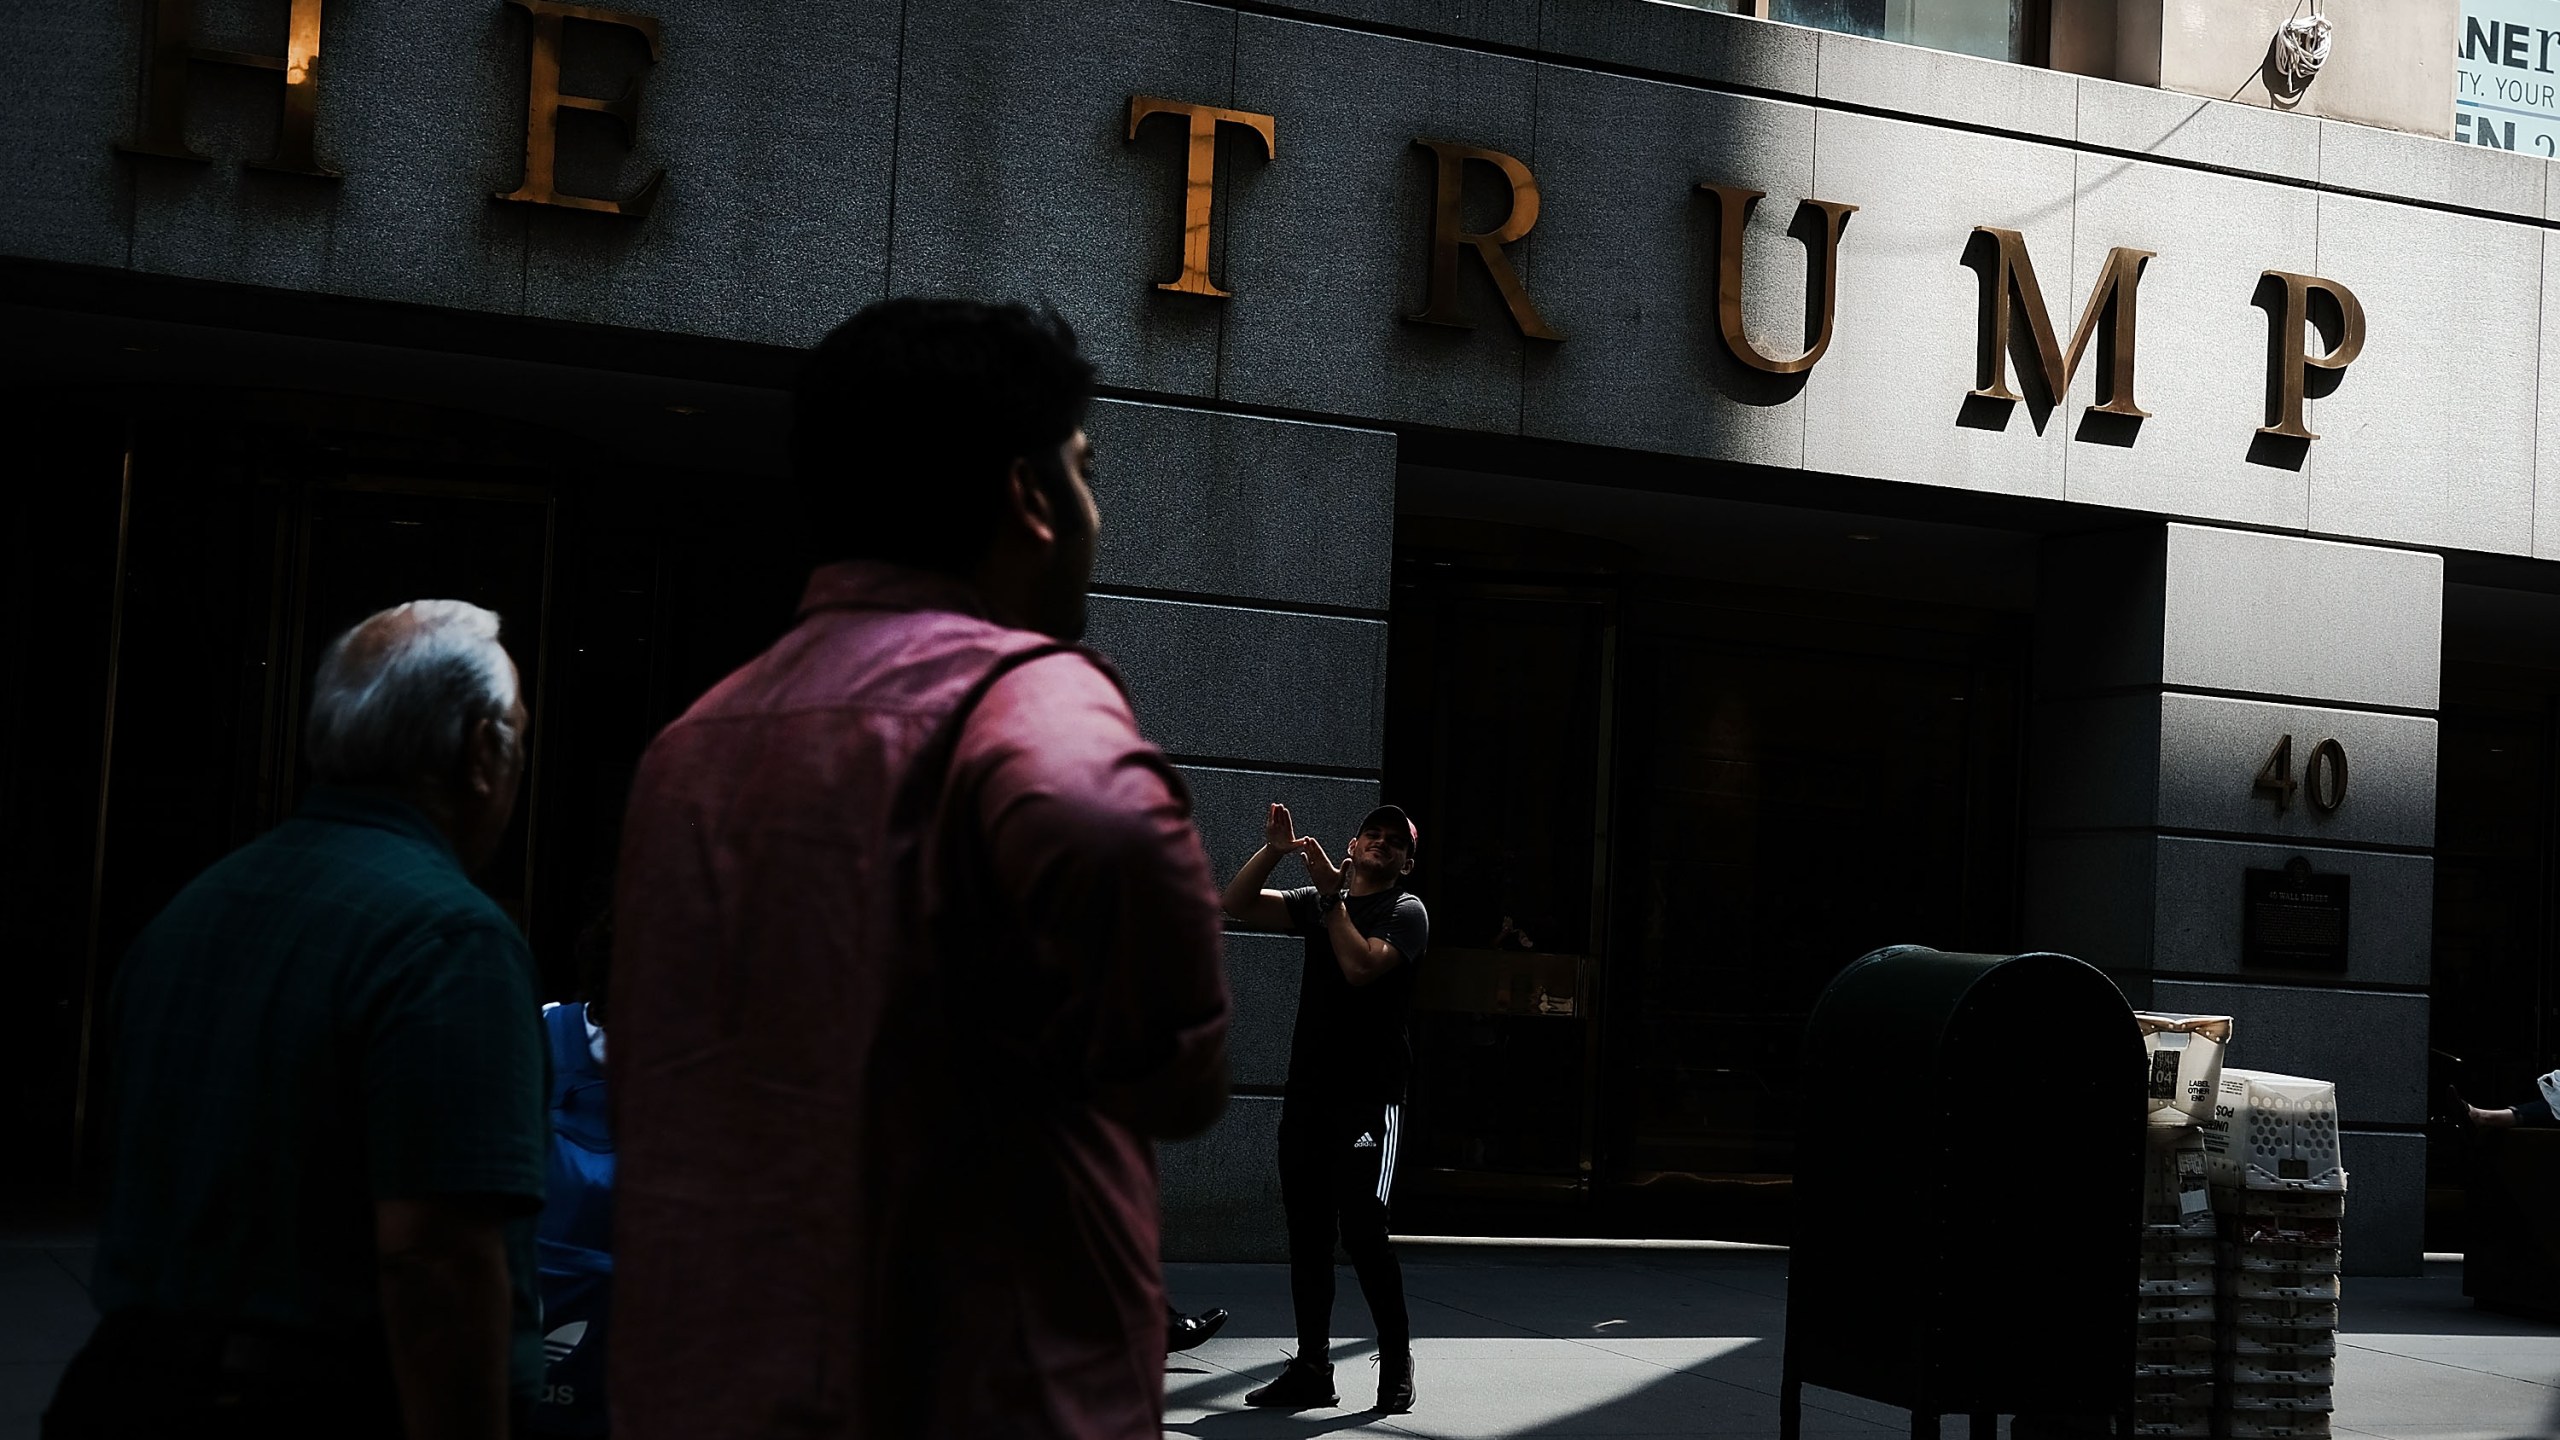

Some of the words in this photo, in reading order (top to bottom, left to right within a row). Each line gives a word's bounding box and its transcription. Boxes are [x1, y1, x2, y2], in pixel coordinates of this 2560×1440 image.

[2459, 15, 2560, 74] NEr
[2495, 77, 2555, 108] YOUR
[1125, 94, 2367, 440] TRUMP
[2255, 735, 2348, 813] 40
[2189, 1080, 2210, 1088] LABEL
